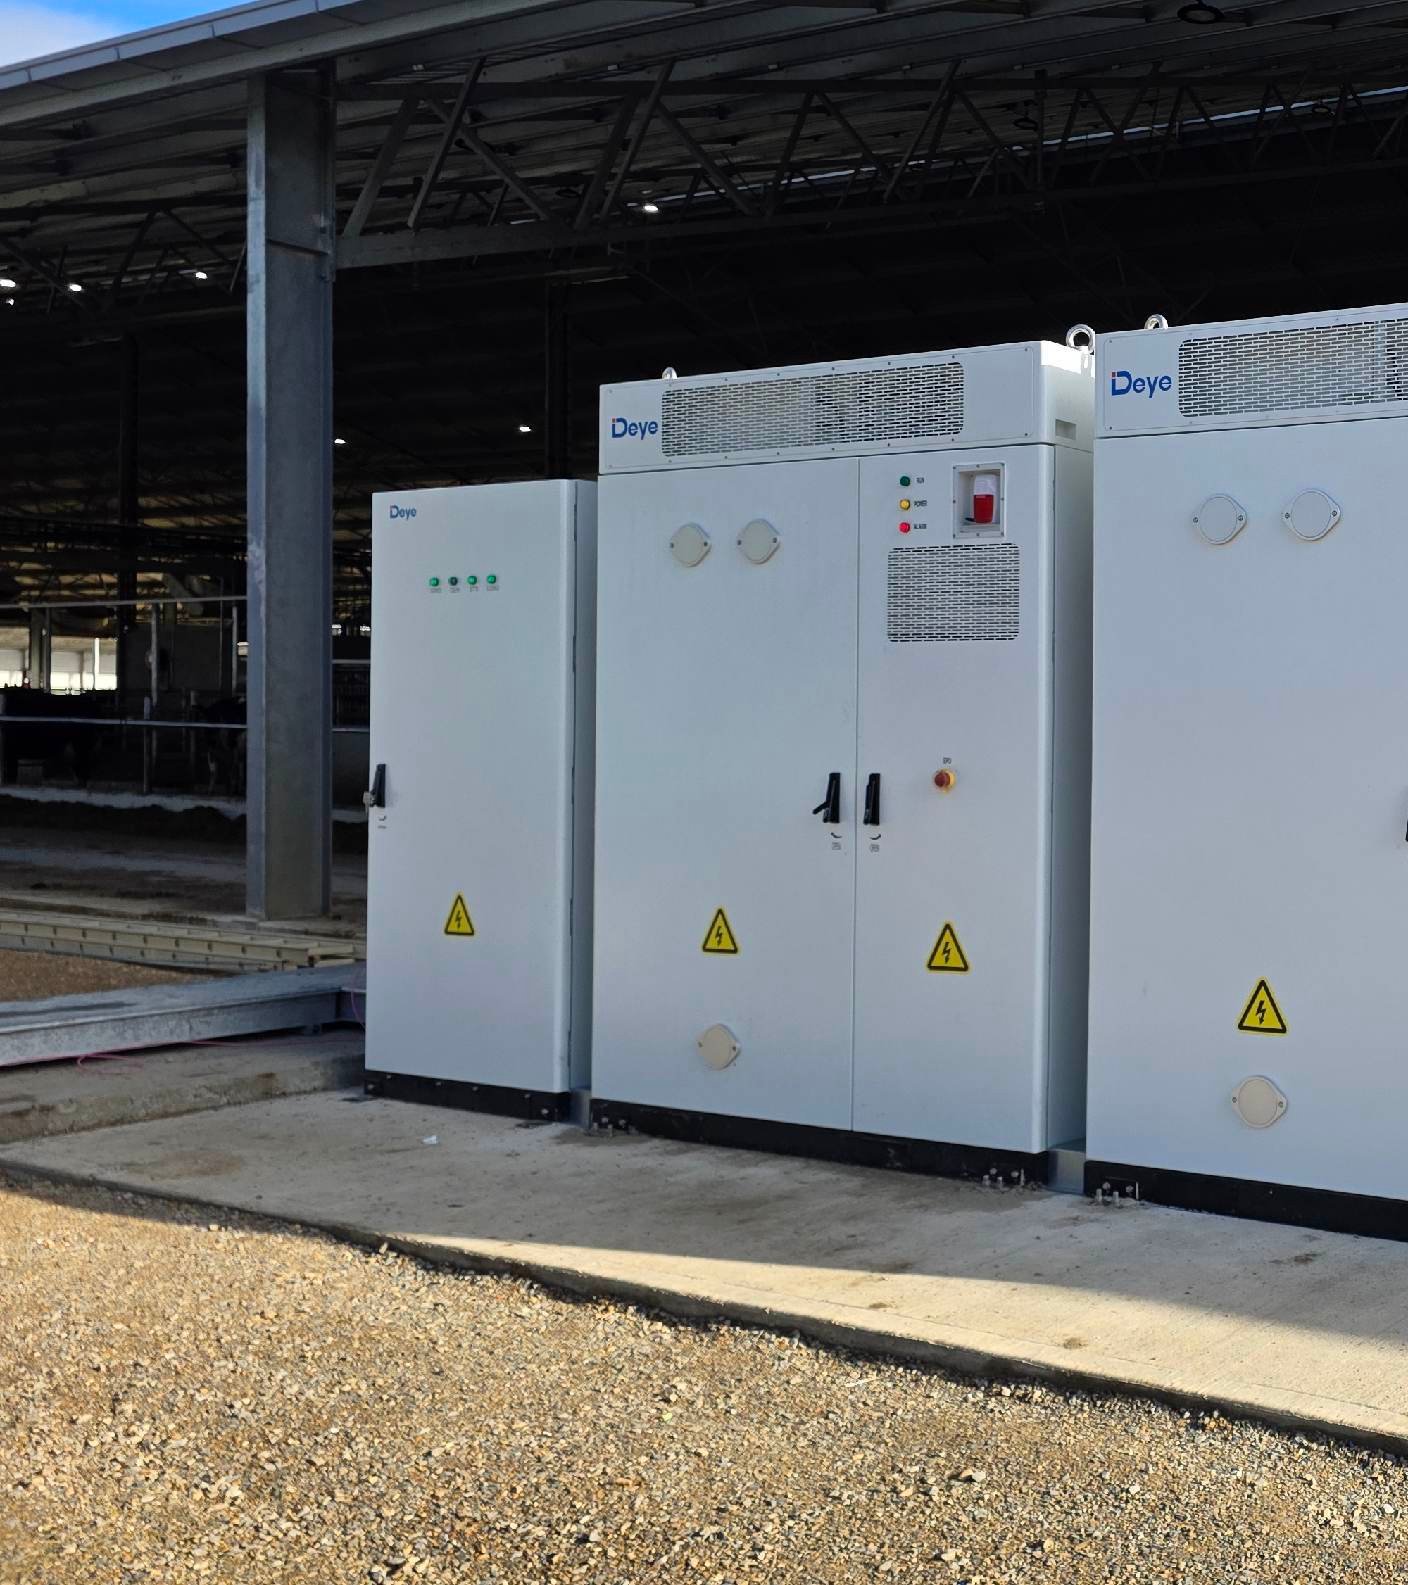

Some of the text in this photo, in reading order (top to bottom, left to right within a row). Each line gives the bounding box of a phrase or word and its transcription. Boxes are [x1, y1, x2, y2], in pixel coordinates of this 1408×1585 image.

[1111, 370, 1172, 399] Deye
[611, 417, 659, 441] Deye
[390, 504, 417, 521] Deye
